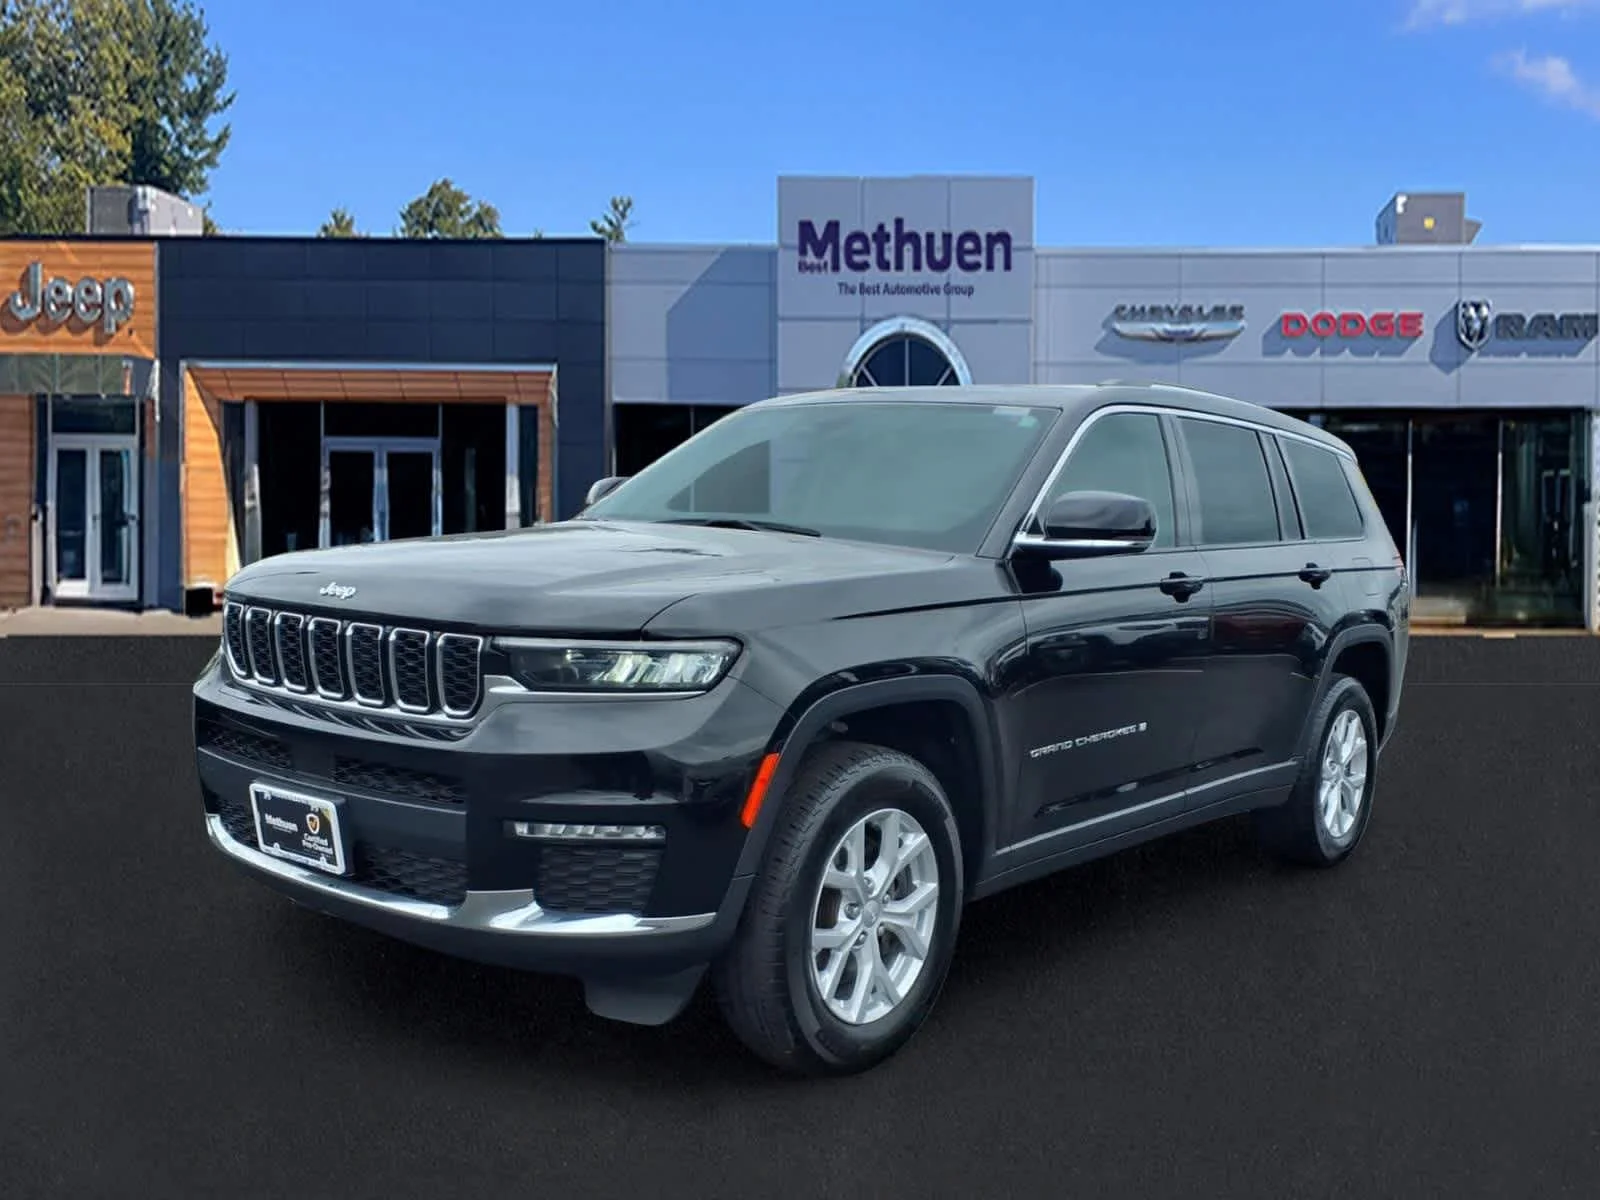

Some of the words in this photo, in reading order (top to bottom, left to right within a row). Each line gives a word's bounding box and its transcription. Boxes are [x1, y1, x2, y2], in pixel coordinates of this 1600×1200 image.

[798, 217, 1012, 273] Methuen
[9, 261, 135, 334] Jeep
[838, 282, 857, 296] The
[859, 282, 881, 296] Best
[883, 282, 942, 296] Automotive
[943, 282, 975, 298] Group
[1114, 304, 1245, 321] CHRYSLER
[1281, 311, 1424, 337] DODGE
[1496, 313, 1599, 338] RAM
[319, 581, 356, 600] Jeep
[1030, 740, 1073, 758] GRAND
[264, 814, 298, 832] Methuen
